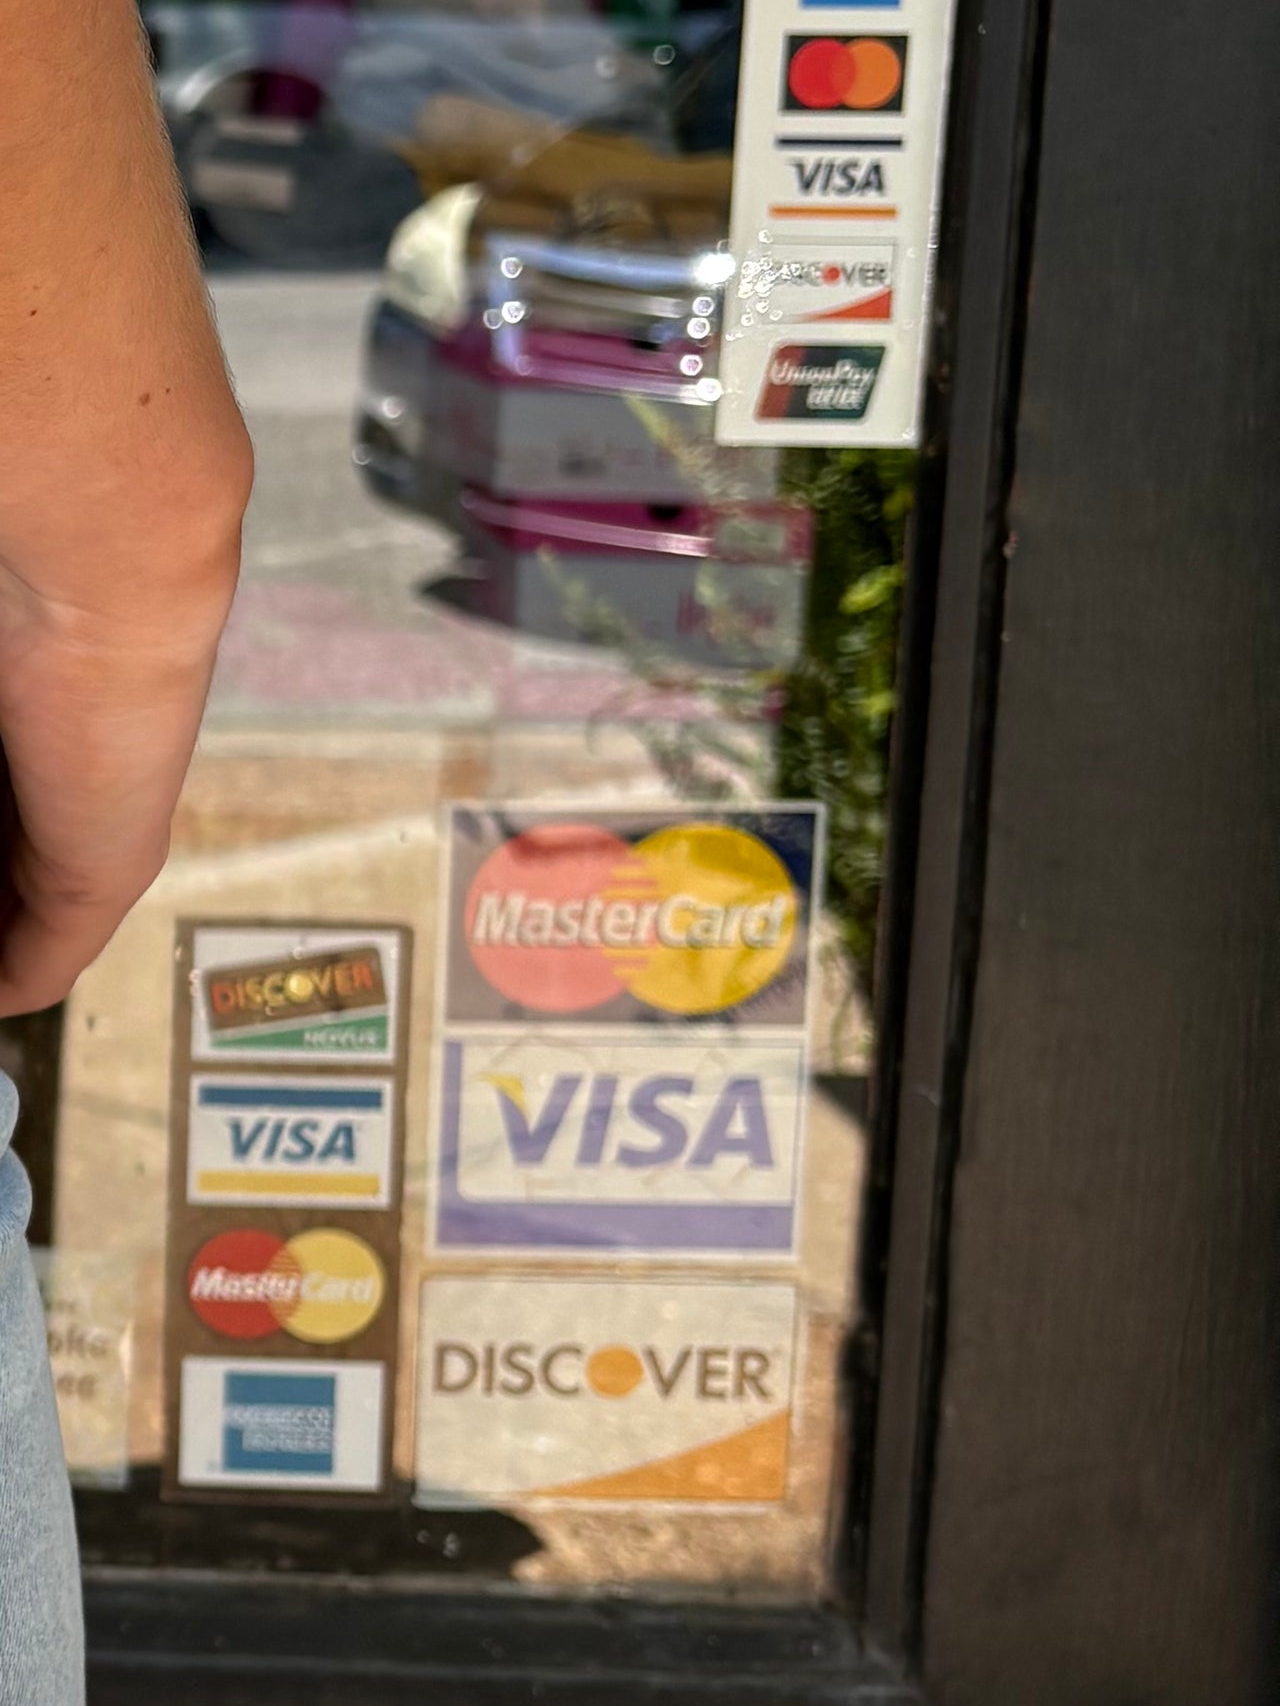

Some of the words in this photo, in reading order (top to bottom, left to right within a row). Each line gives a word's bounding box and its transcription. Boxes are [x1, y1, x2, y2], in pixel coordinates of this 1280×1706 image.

[790, 158, 885, 194] VISA
[472, 890, 787, 948] MasterCard
[211, 958, 375, 1015] DISCOVER
[228, 1117, 357, 1161] VISA
[482, 1071, 775, 1169] VISA
[191, 1267, 377, 1302] MasterCard
[432, 1343, 773, 1400] DISCOVER
